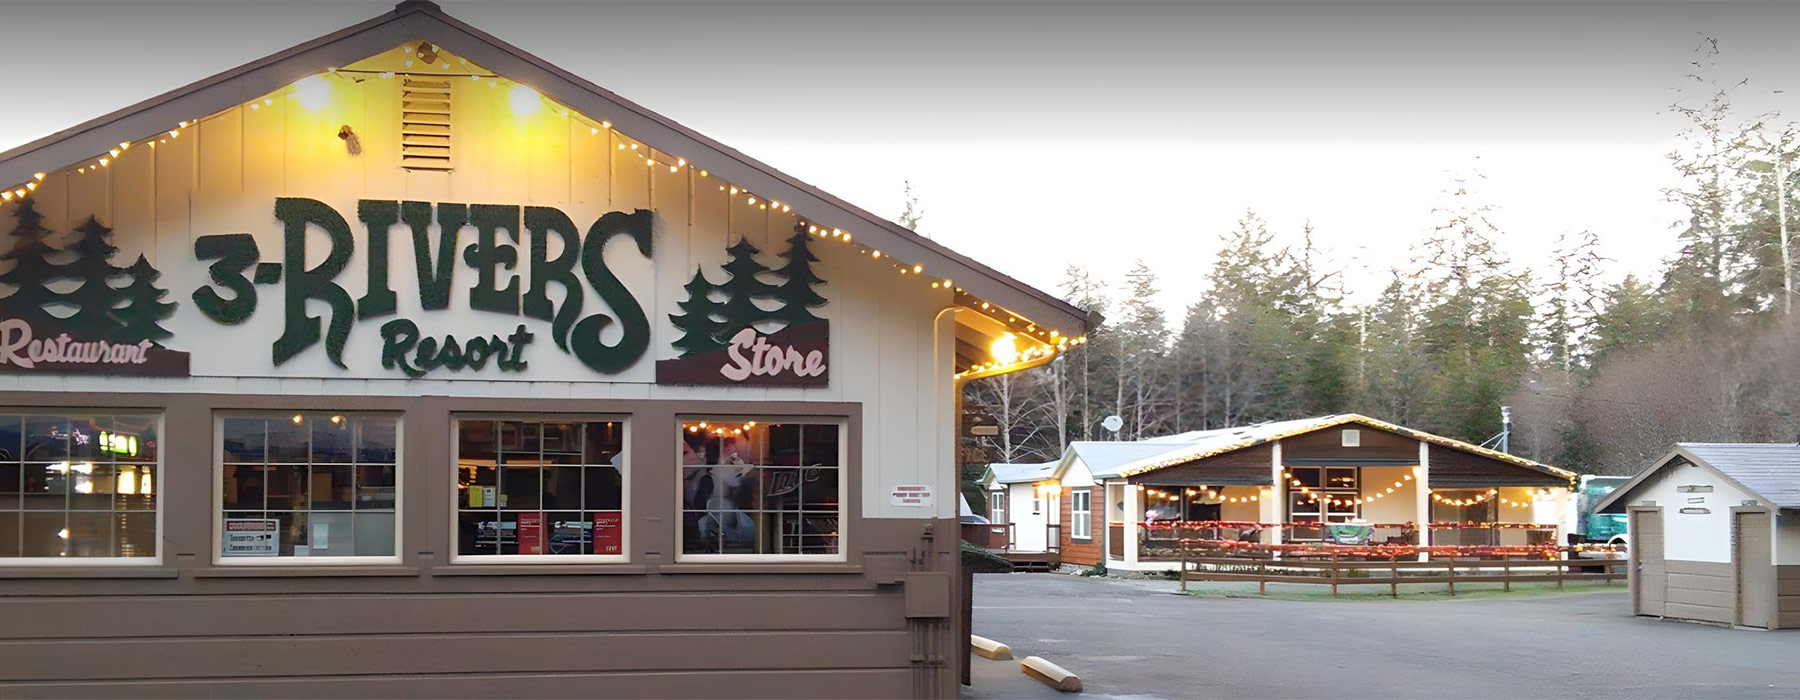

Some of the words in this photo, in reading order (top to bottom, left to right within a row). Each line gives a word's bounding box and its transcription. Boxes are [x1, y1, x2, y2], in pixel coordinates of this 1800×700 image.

[192, 197, 656, 375] 3-RIVERS
[0, 318, 153, 369] Restaurant
[380, 318, 534, 378] Resort
[720, 328, 826, 381] Store
